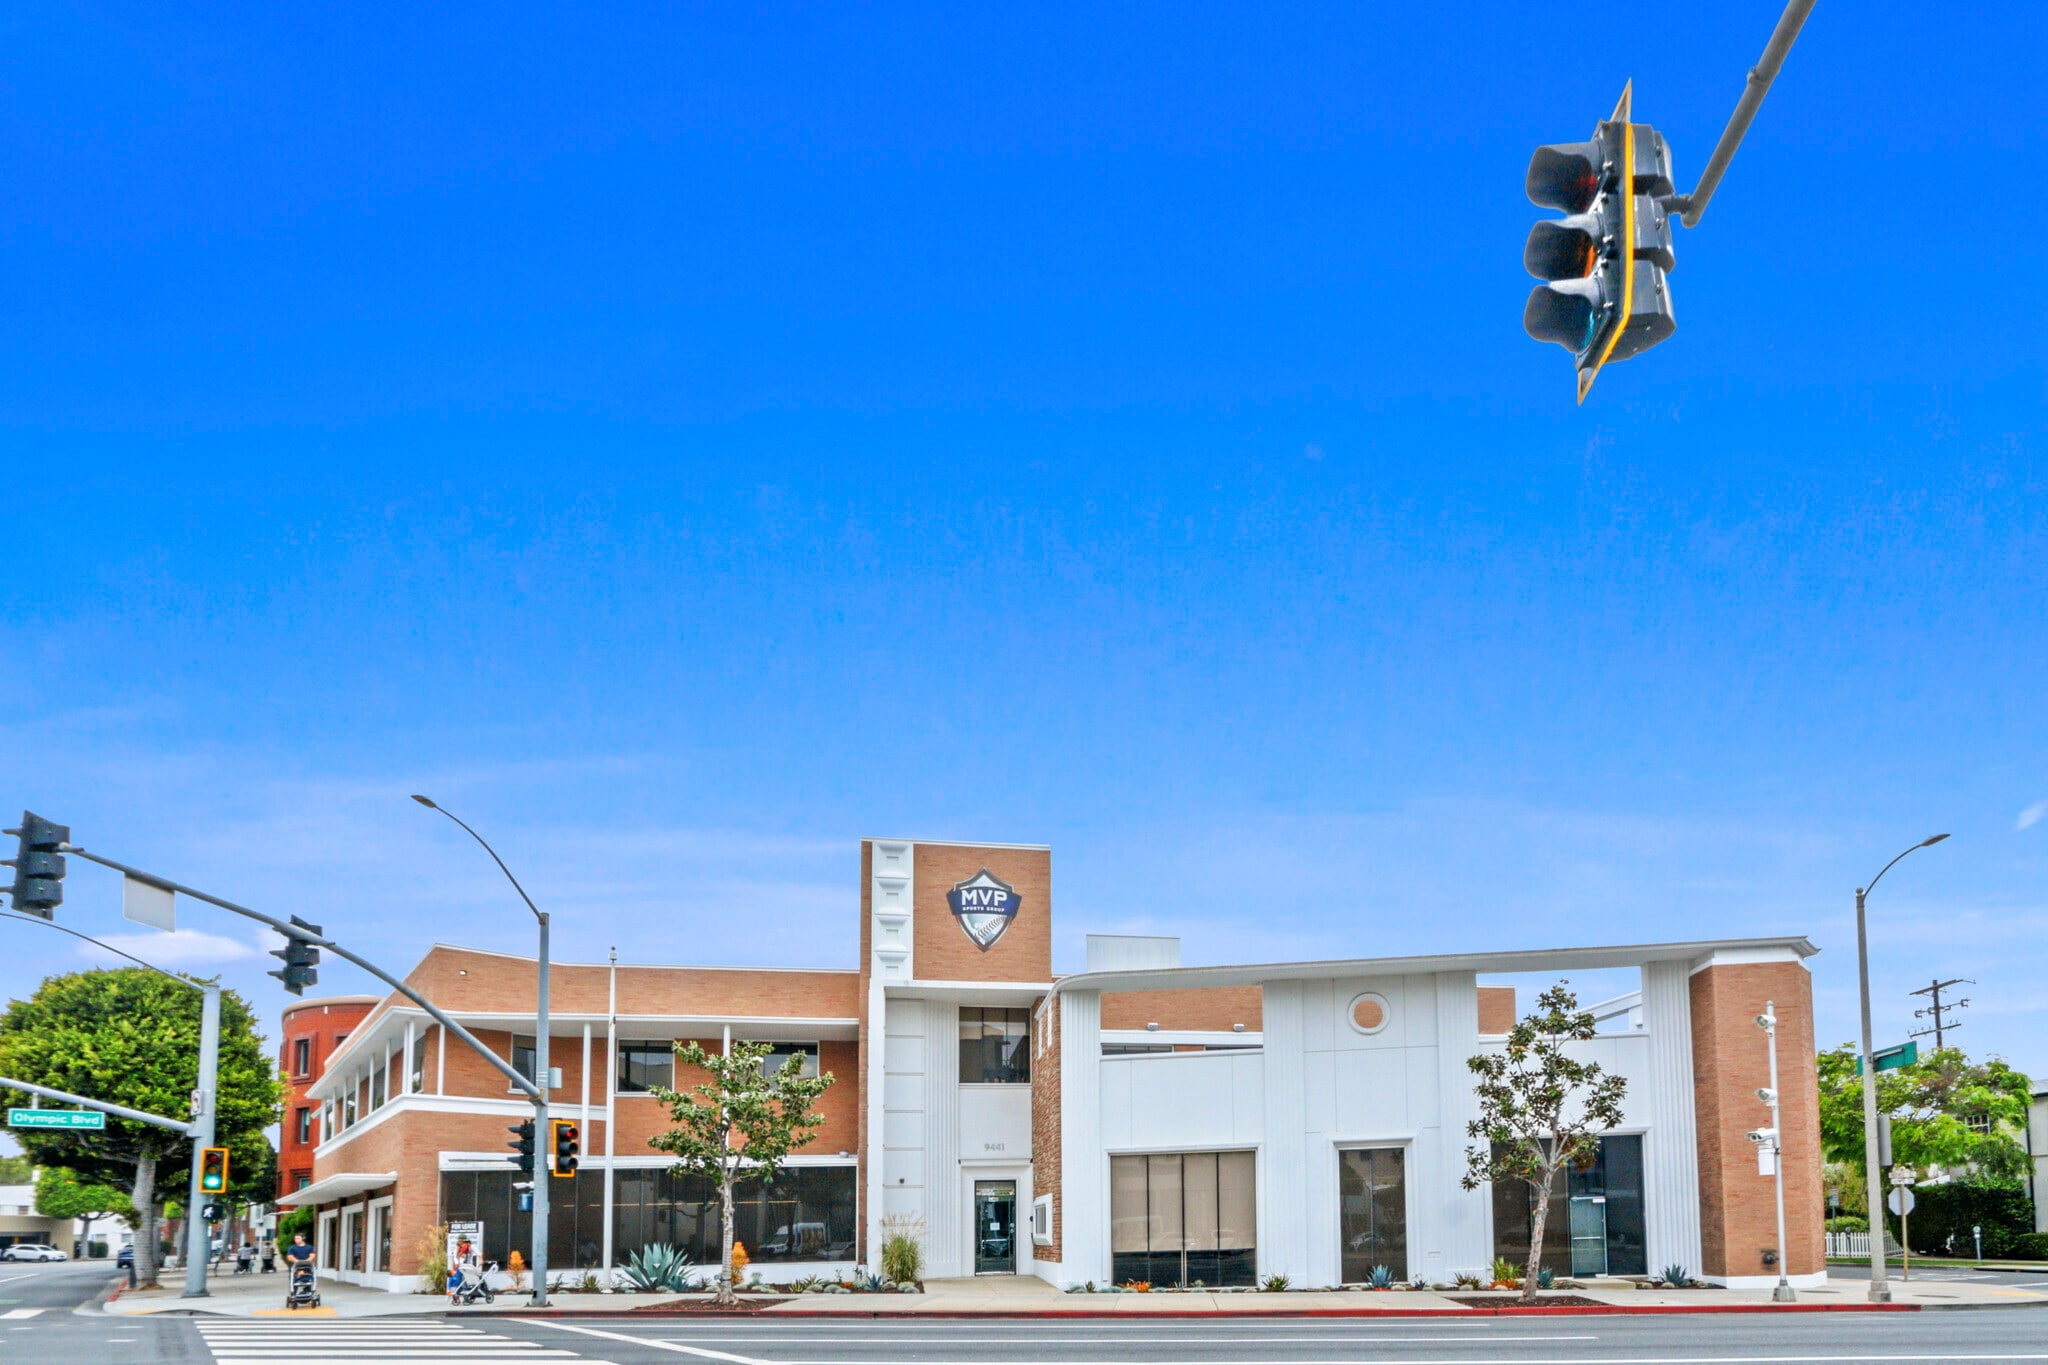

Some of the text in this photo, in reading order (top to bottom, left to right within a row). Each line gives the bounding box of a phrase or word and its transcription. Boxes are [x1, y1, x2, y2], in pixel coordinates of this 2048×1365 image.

[961, 889, 1008, 906] MVP
[13, 1113, 100, 1125] Olympic Blvd
[984, 1143, 1005, 1151] 9441
